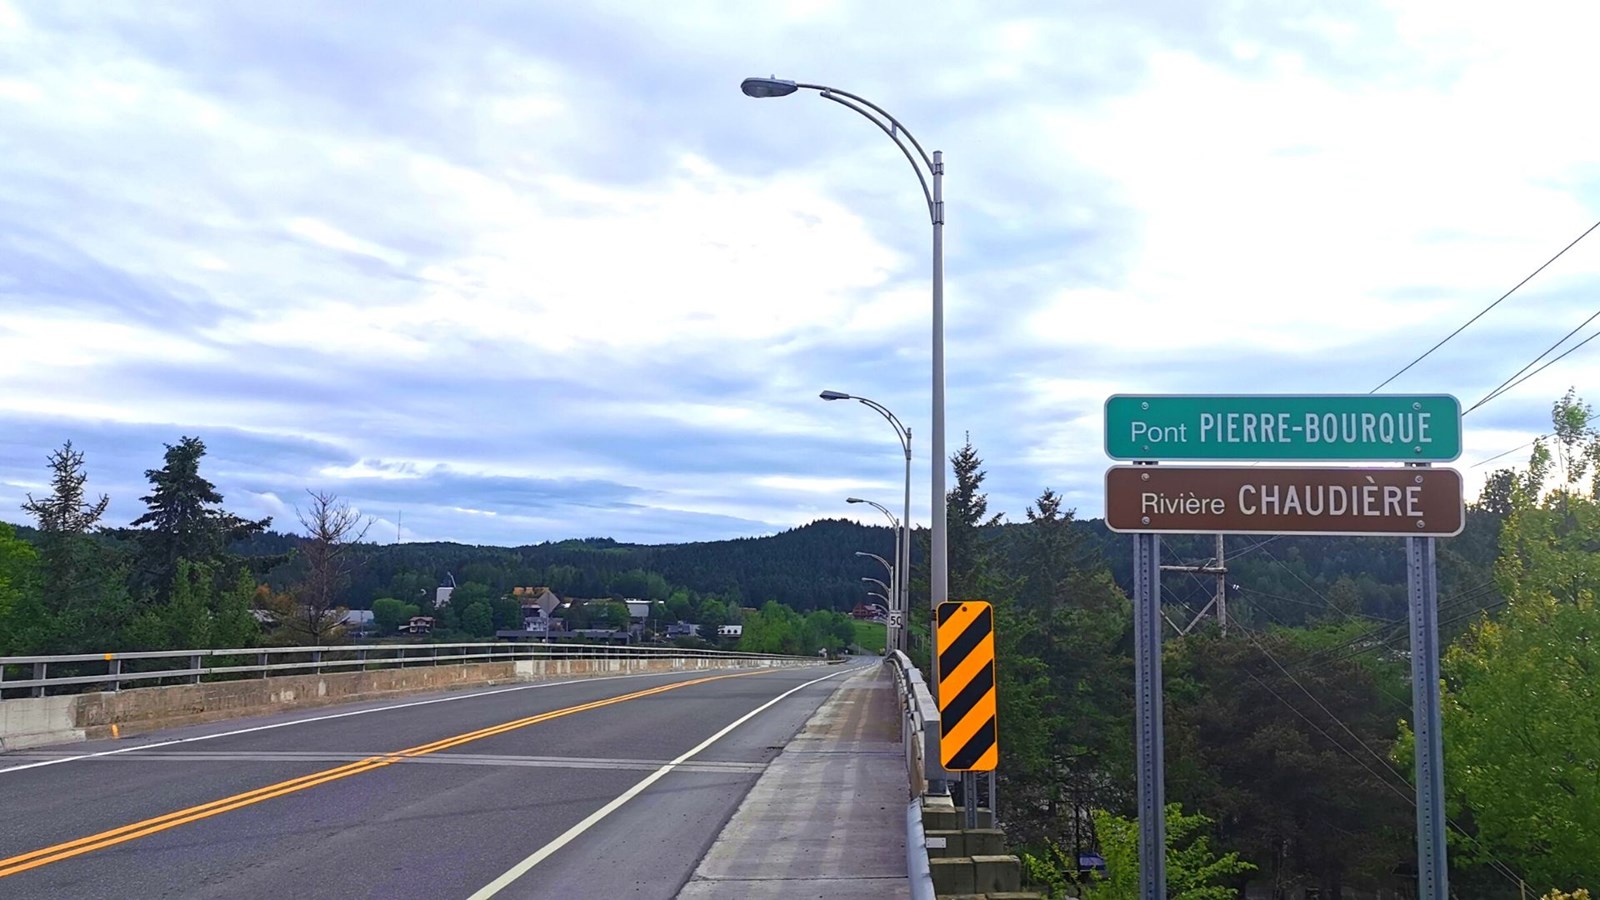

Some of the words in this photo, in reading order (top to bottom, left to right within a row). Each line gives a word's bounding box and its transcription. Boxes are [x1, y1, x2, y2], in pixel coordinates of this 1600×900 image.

[1131, 422, 1187, 443] Pont
[1200, 412, 1432, 444] PIERRE-BOURQUE
[1141, 491, 1225, 515] Rivière
[1238, 475, 1424, 517] CHAUDIÈRE
